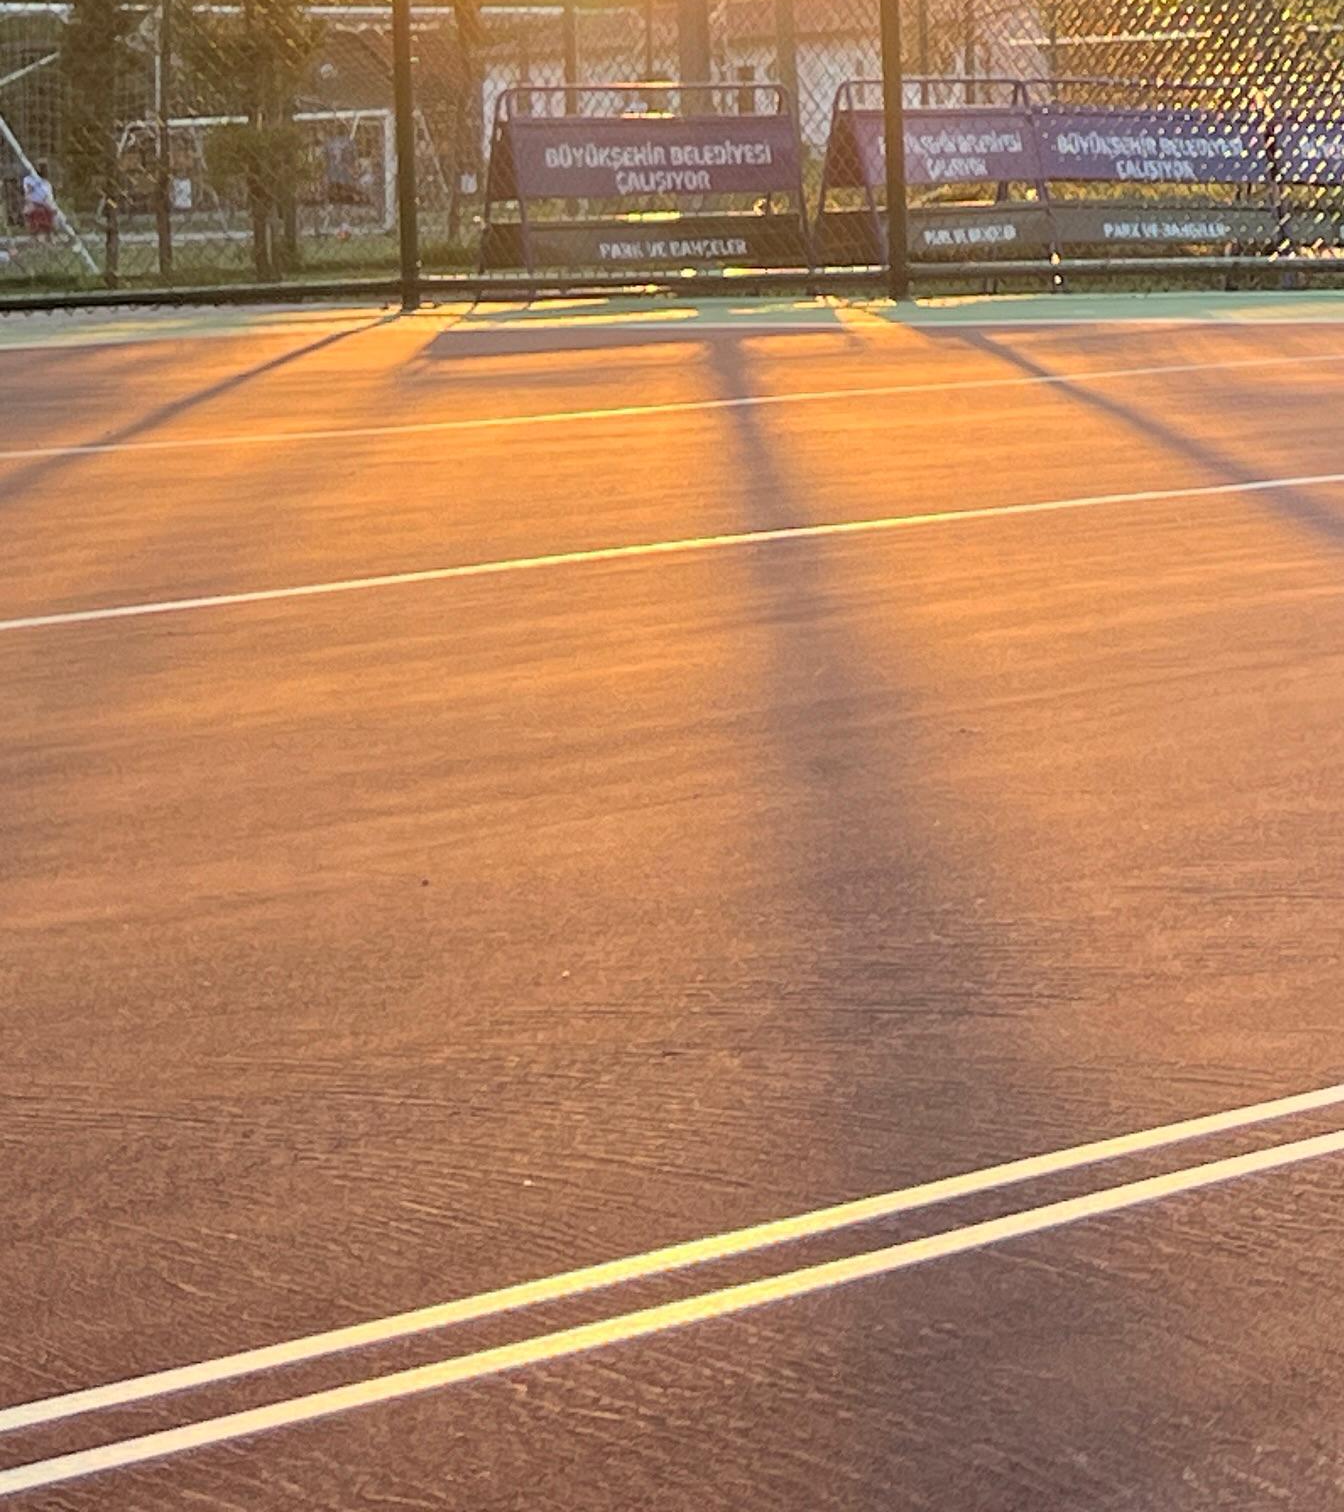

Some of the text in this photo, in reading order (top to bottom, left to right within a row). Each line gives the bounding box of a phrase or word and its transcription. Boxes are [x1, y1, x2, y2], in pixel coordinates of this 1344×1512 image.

[545, 139, 772, 171] BÜYÜKŞEHİR BELEDİYESİ
[615, 170, 711, 195] ÇALIŞIYOR
